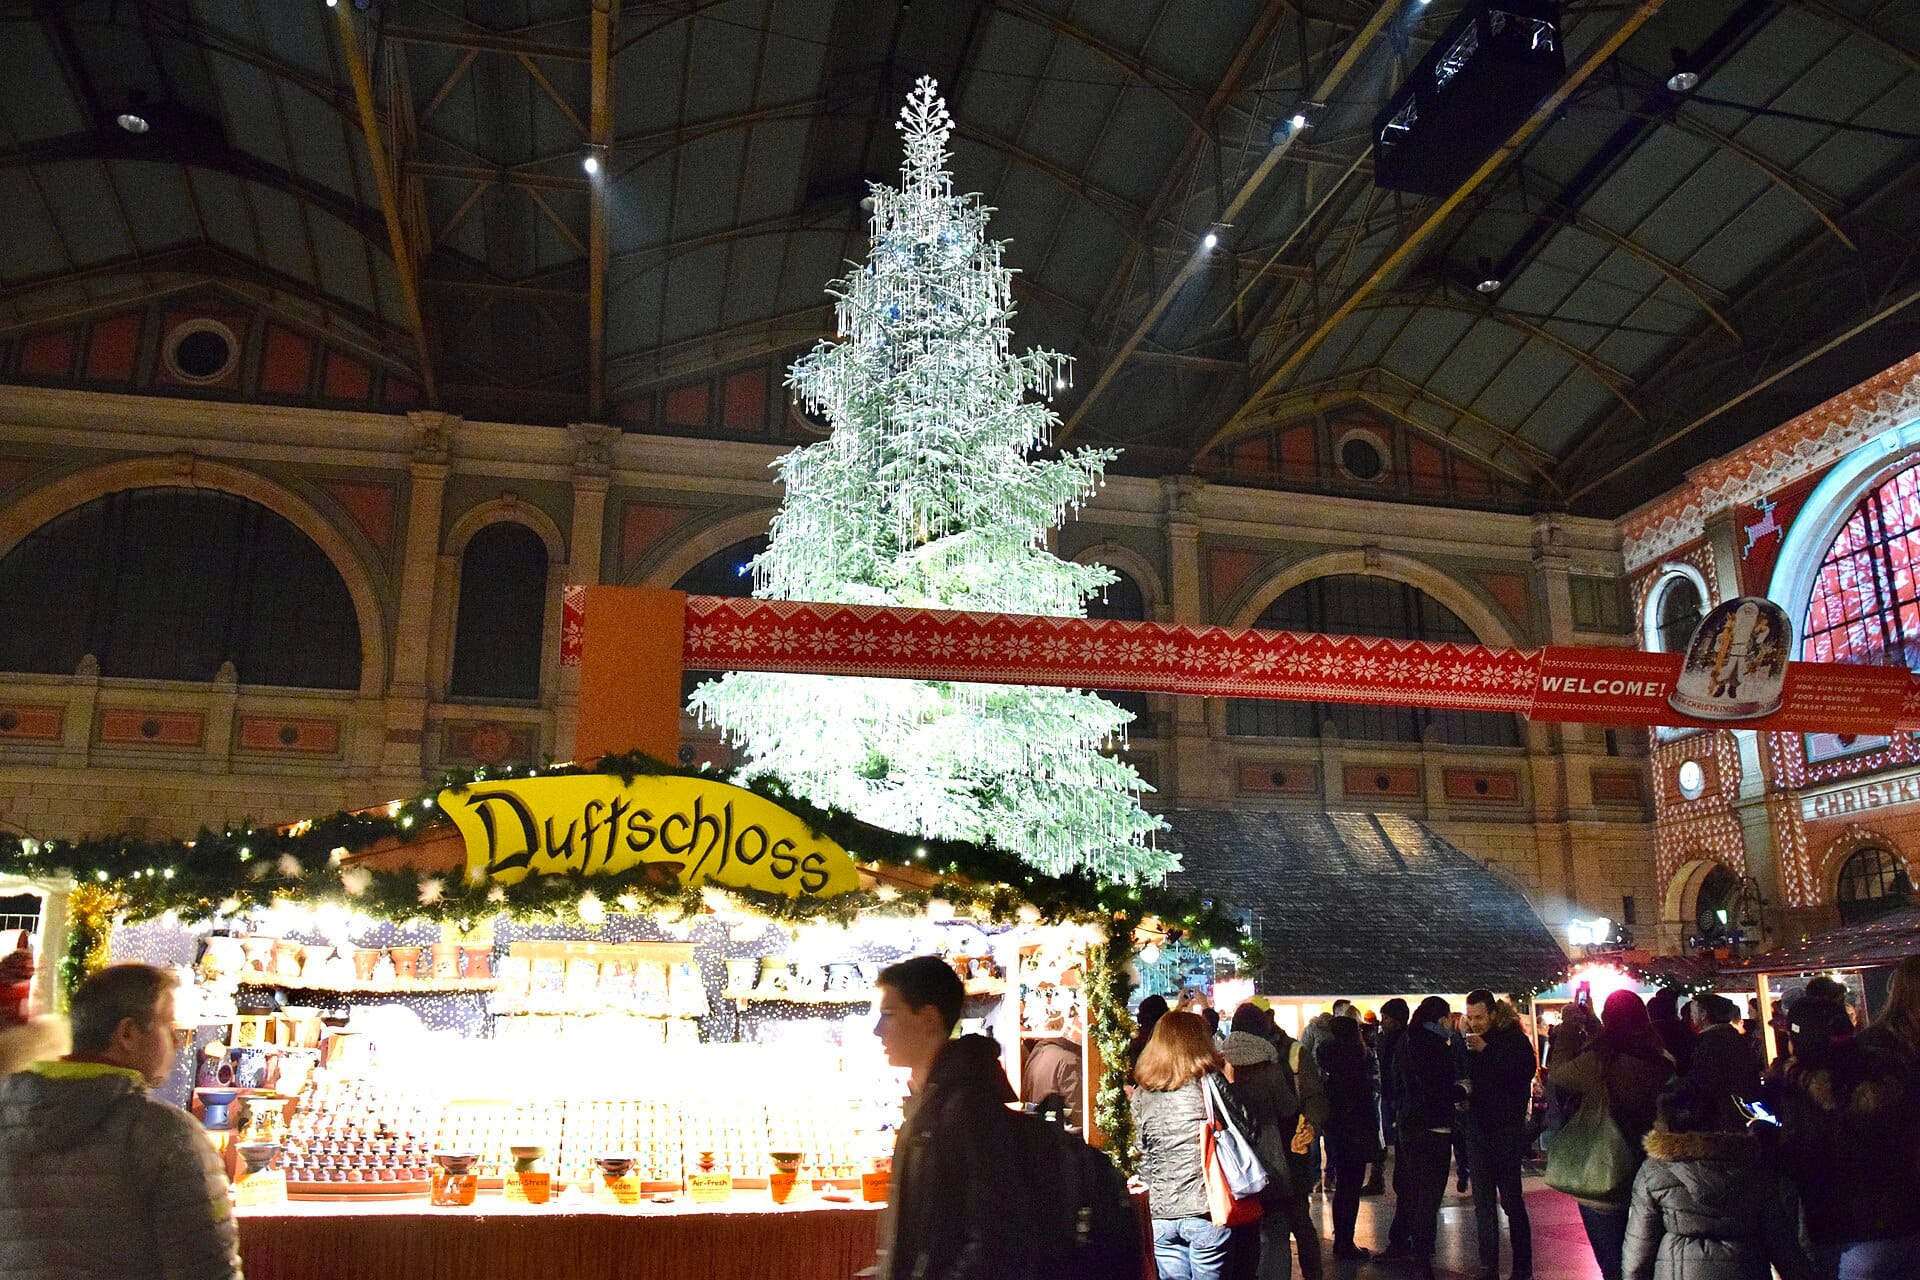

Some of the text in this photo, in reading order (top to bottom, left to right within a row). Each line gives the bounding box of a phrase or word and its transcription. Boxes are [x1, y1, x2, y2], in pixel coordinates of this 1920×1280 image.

[1541, 676, 1667, 697] WELCOME!
[1822, 695, 1861, 703] BEVERAGE
[465, 790, 829, 893] Duftschloss
[506, 1179, 549, 1187] Anti-Stress
[692, 1179, 728, 1187] Air-Fresh
